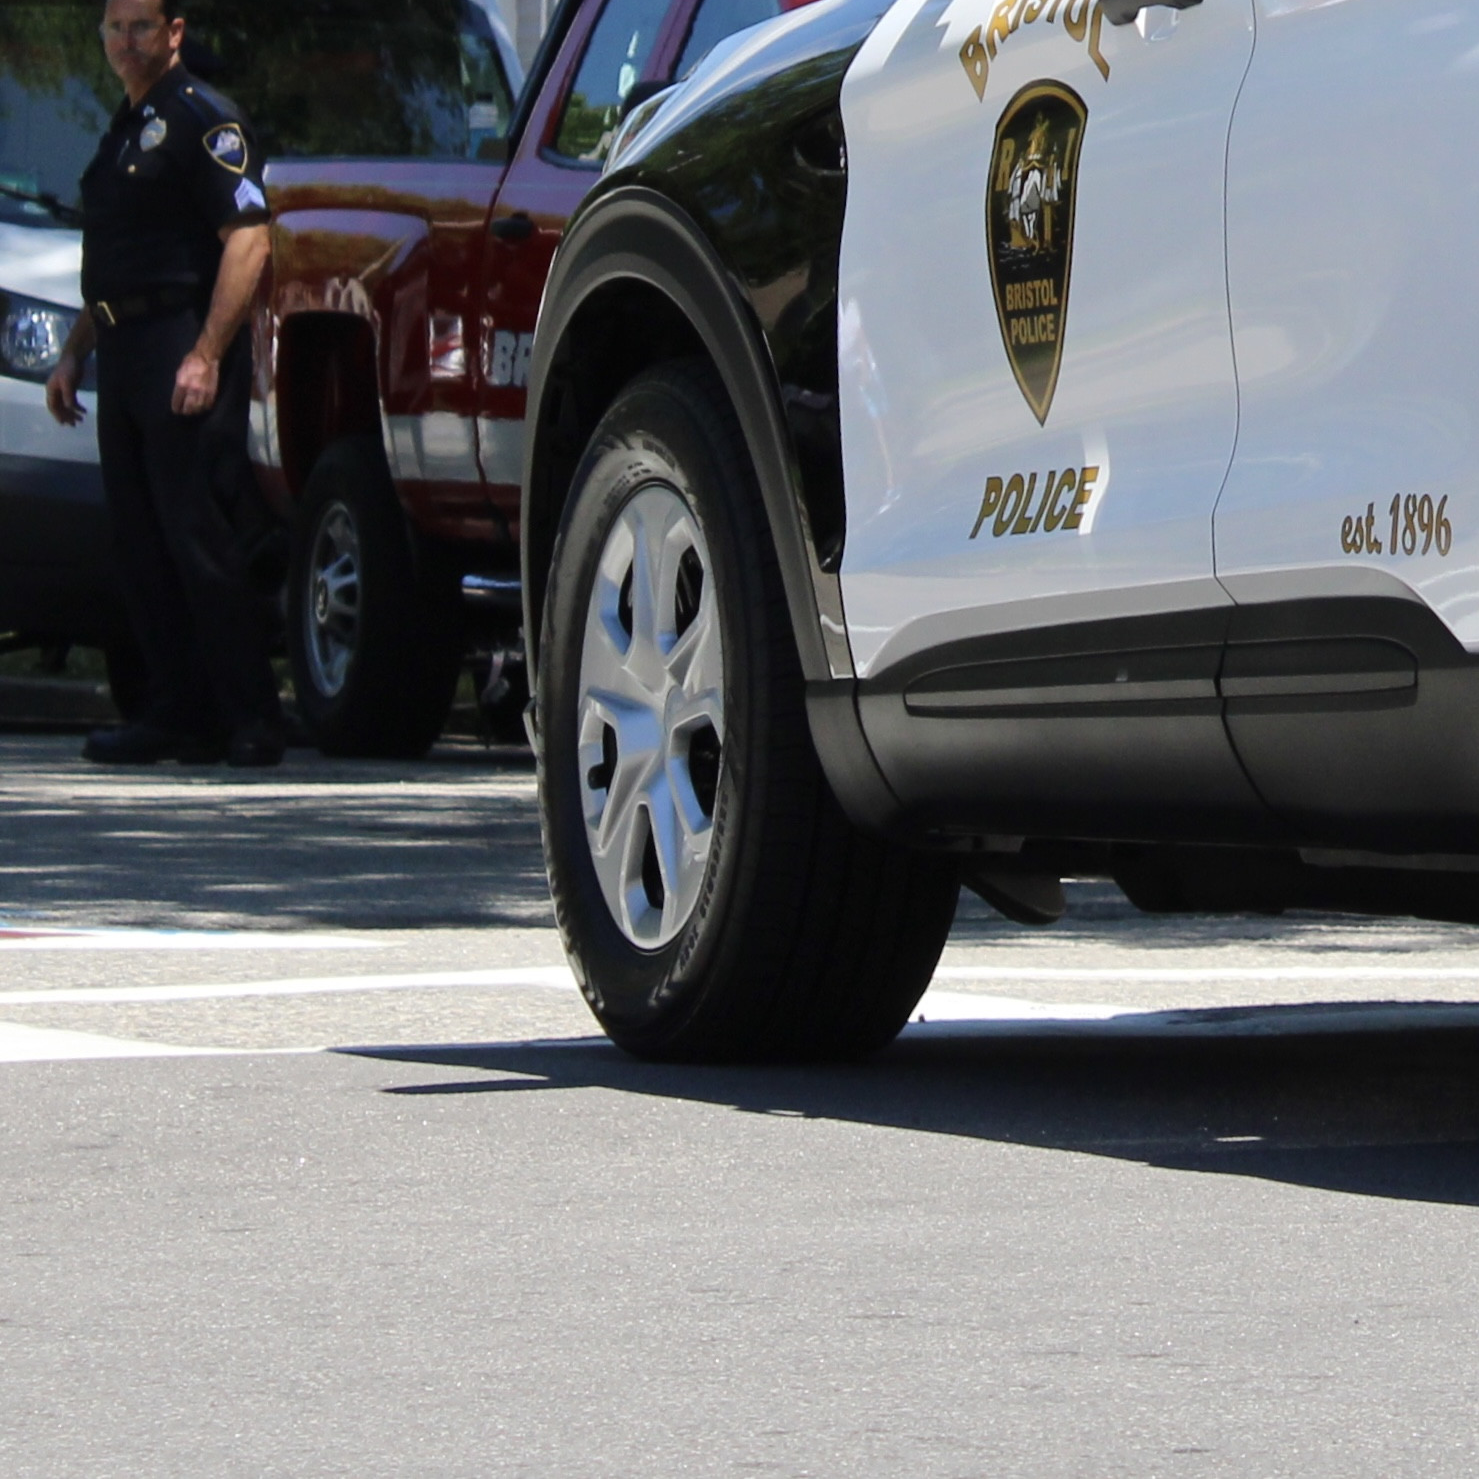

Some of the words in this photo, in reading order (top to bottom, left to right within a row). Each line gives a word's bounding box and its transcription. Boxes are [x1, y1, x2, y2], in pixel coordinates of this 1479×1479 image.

[995, 138, 1015, 193] R
[1006, 280, 1058, 312] BRISTOL
[1010, 314, 1056, 347] POLICE
[968, 465, 1101, 541] POLICE
[1340, 507, 1382, 556] est.
[1389, 492, 1453, 558] 1896
